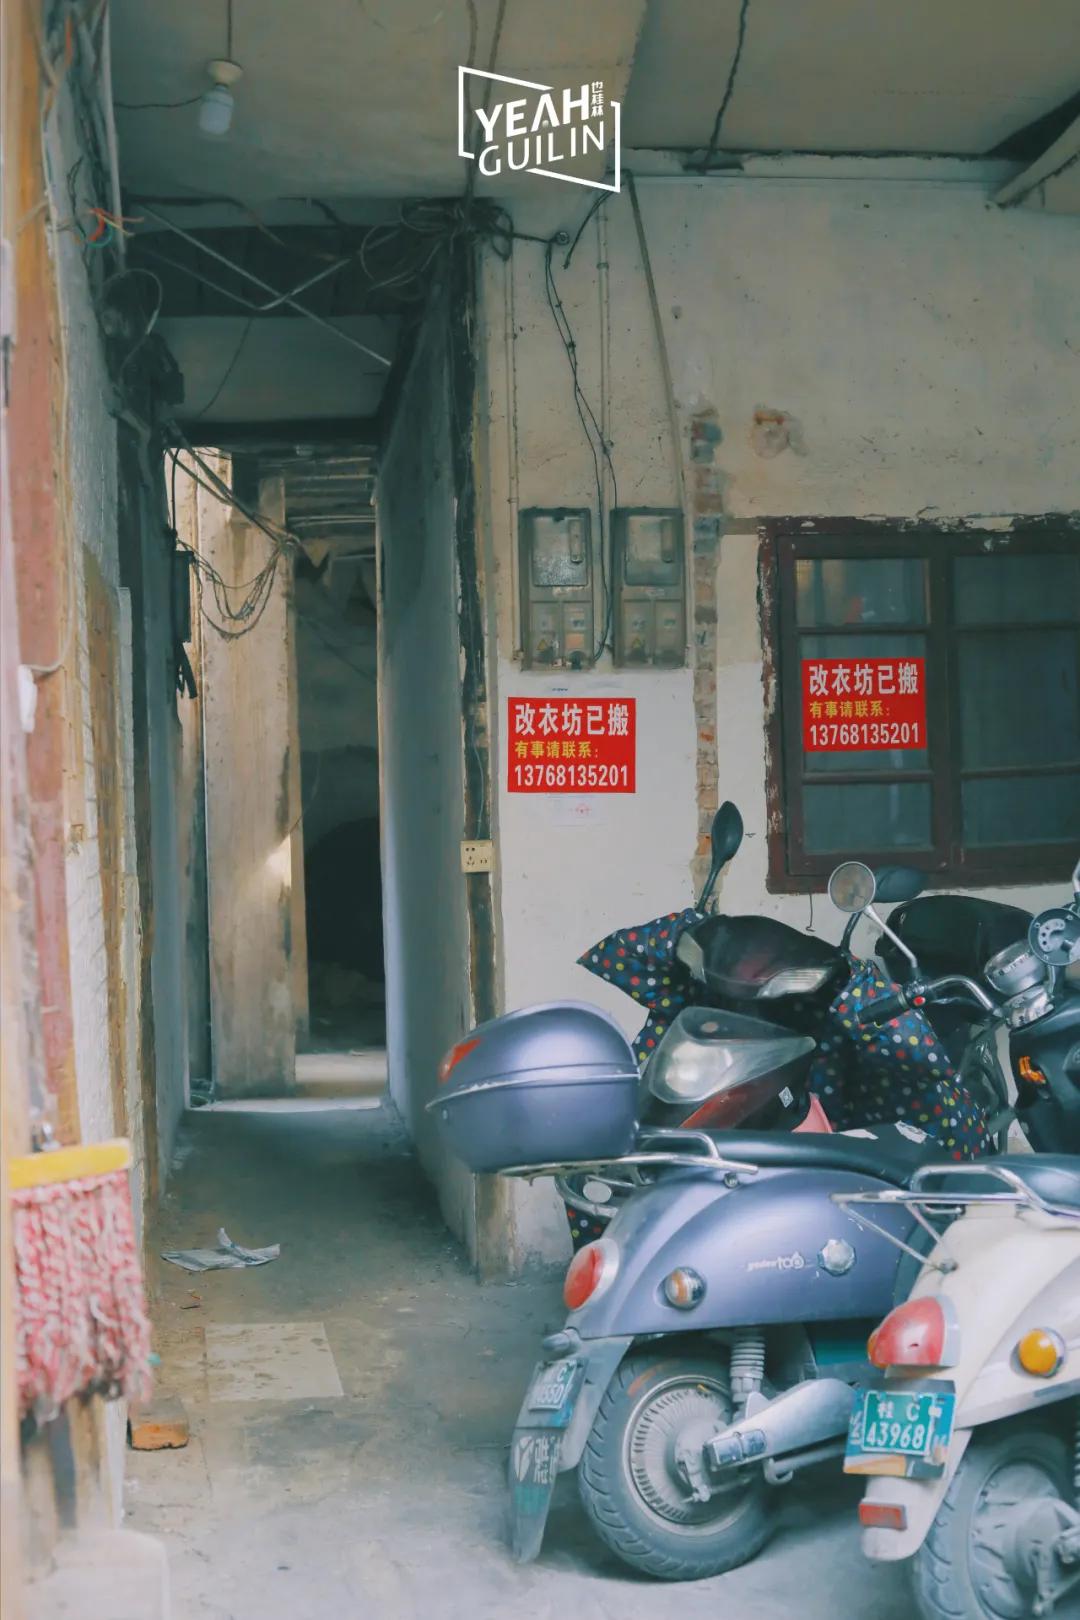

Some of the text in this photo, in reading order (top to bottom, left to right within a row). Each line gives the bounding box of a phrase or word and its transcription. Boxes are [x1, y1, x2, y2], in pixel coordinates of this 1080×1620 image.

[808, 662, 919, 696] 改衣坊已搬
[514, 703, 629, 736] 改衣坊已搬
[810, 722, 919, 746] 13768135201
[514, 764, 628, 787] 13768135201
[866, 1421, 926, 1449] 43968
